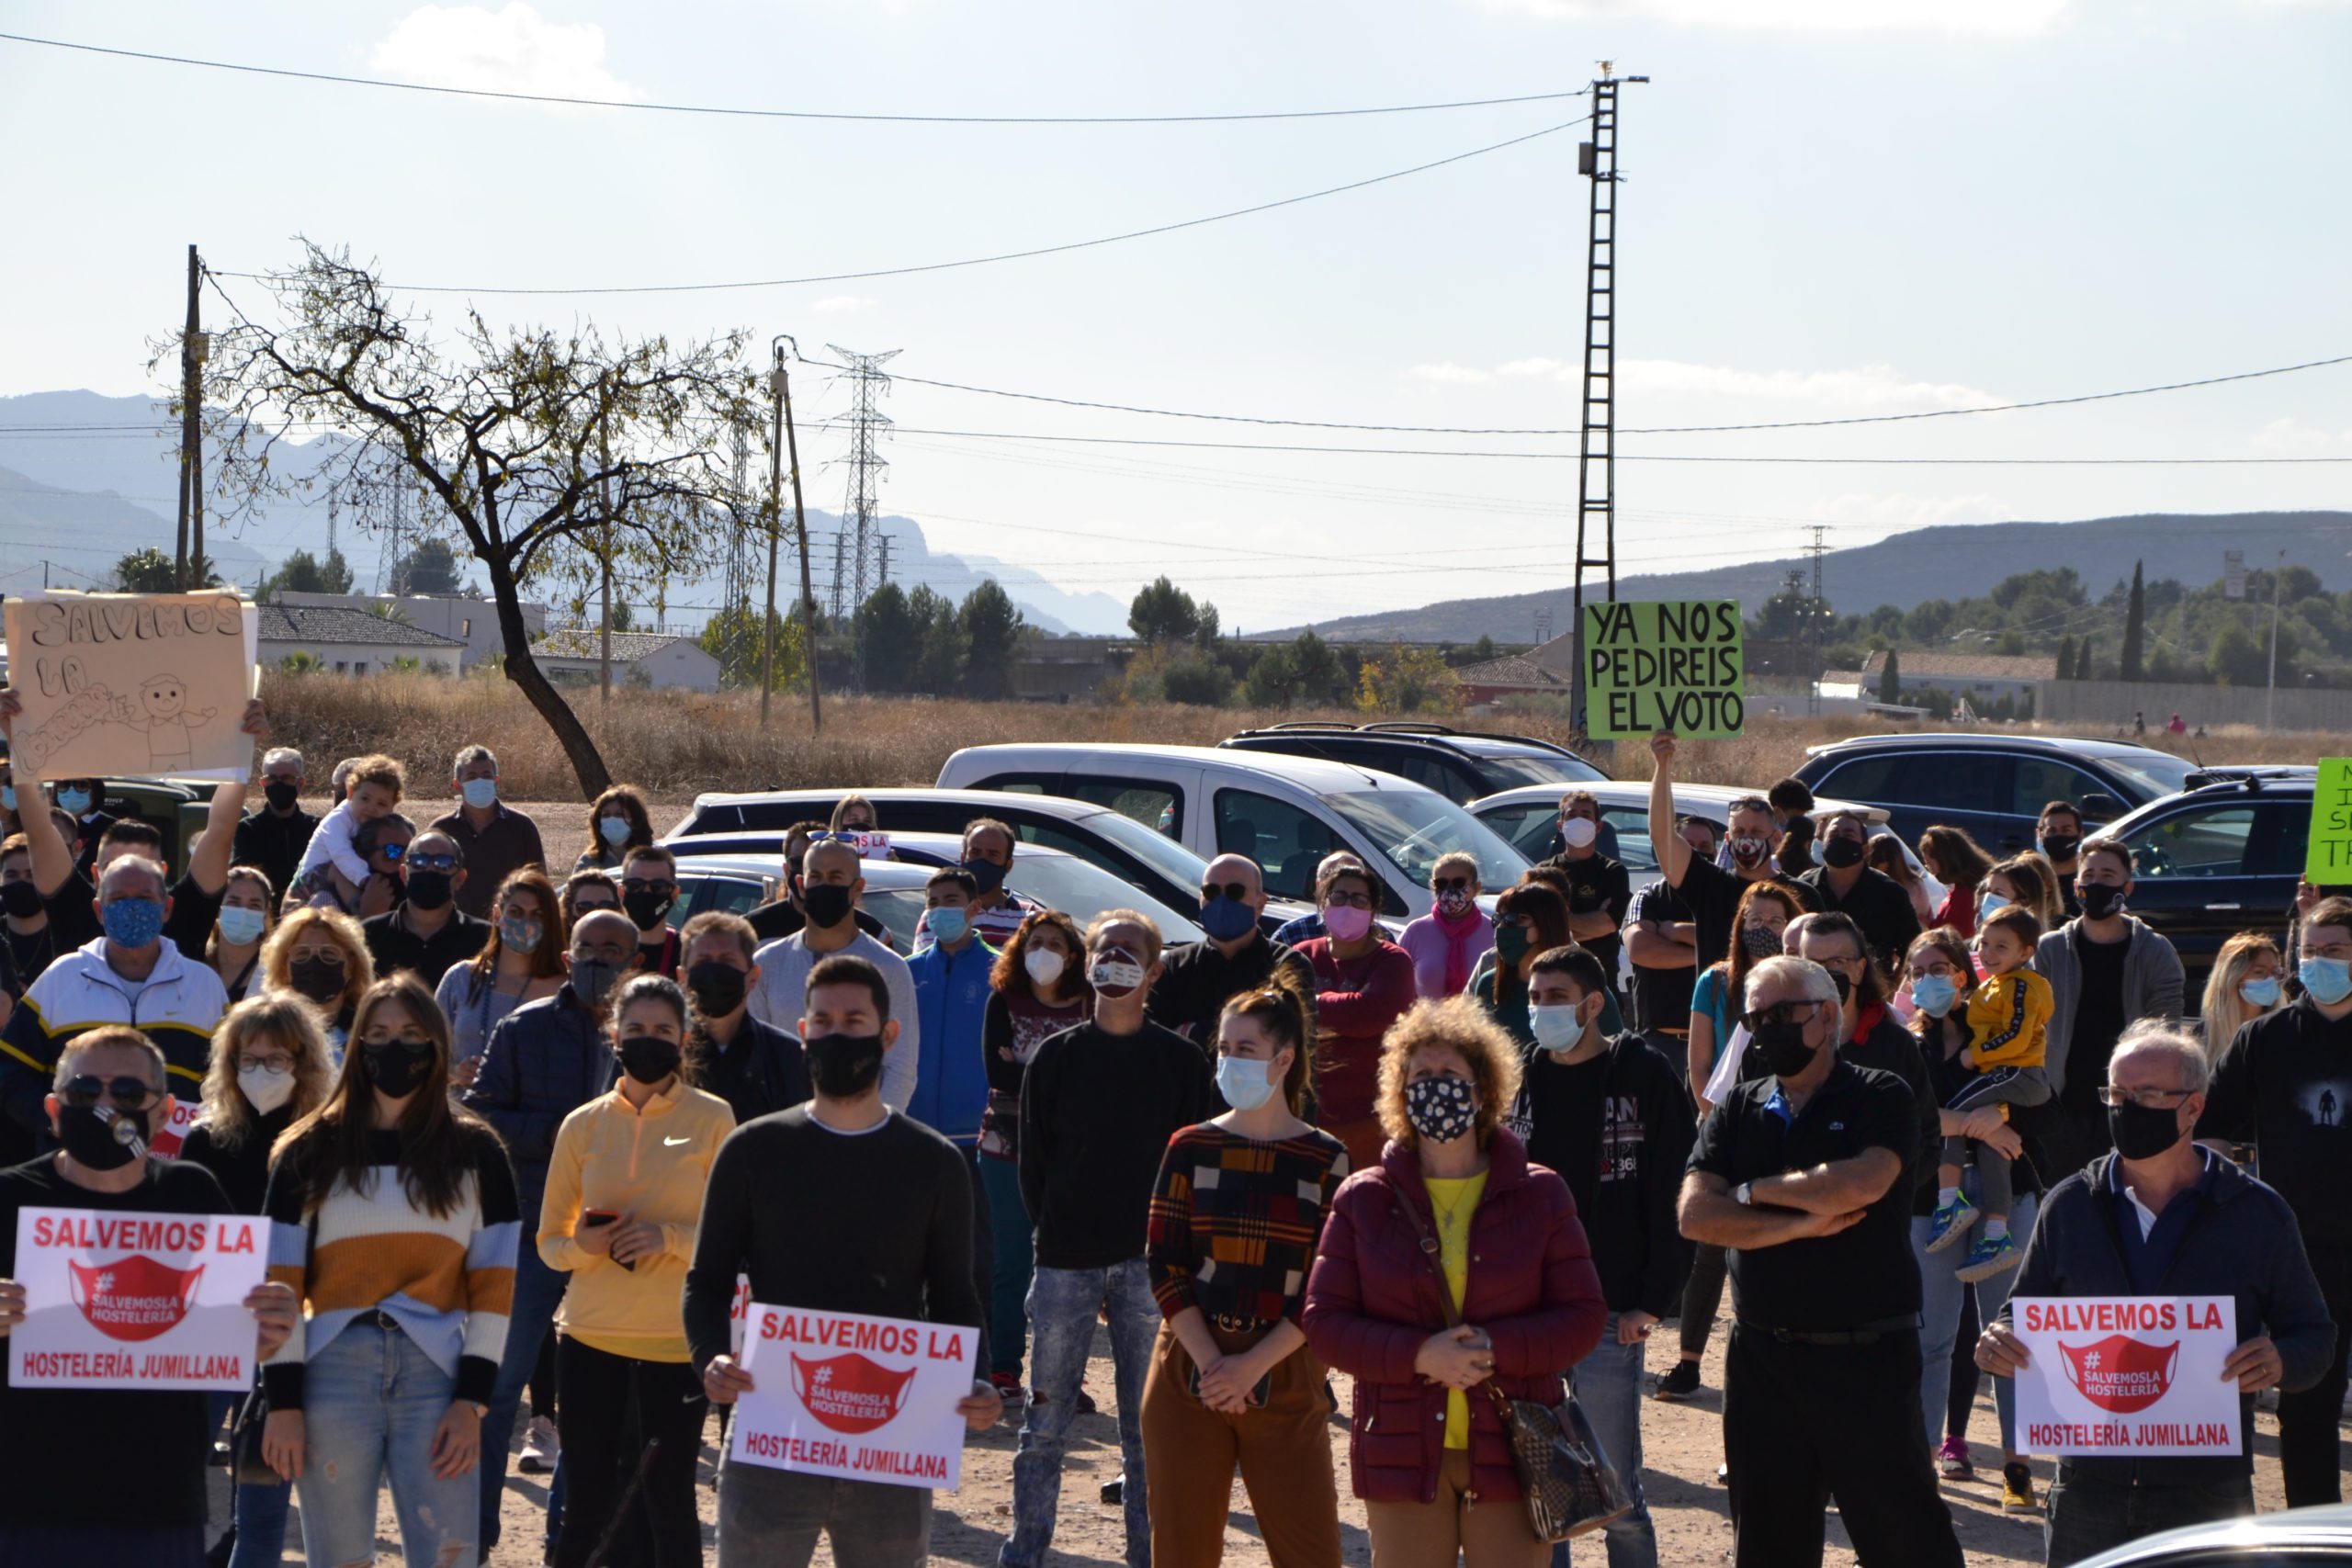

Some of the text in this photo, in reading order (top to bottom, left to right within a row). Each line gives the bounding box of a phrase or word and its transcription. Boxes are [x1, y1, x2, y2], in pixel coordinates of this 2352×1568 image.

[32, 597, 243, 648] SALVEMOS
[1589, 603, 1736, 644] YA NOS
[36, 655, 88, 698] LA
[1590, 646, 1738, 688] PEDIREIS
[1609, 691, 1652, 732] EL
[1654, 691, 1744, 732] VOTO
[34, 1217, 254, 1253] SALVEMOS LA
[92, 1293, 178, 1310] SALVEMOSLA
[2026, 1303, 2223, 1331] SALVEMOS LA
[760, 1313, 964, 1361] SALVEMOS LA
[23, 1348, 241, 1380] HOSTELERÍA JUMILLANA
[2084, 1370, 2161, 1384] SALVEMOSLA
[810, 1384, 890, 1407] SALVEMOSLA
[2030, 1419, 2230, 1447] HOSTELERÍA JUMILLANA
[746, 1431, 947, 1480] HOSTELERÍA JUMILLANA
